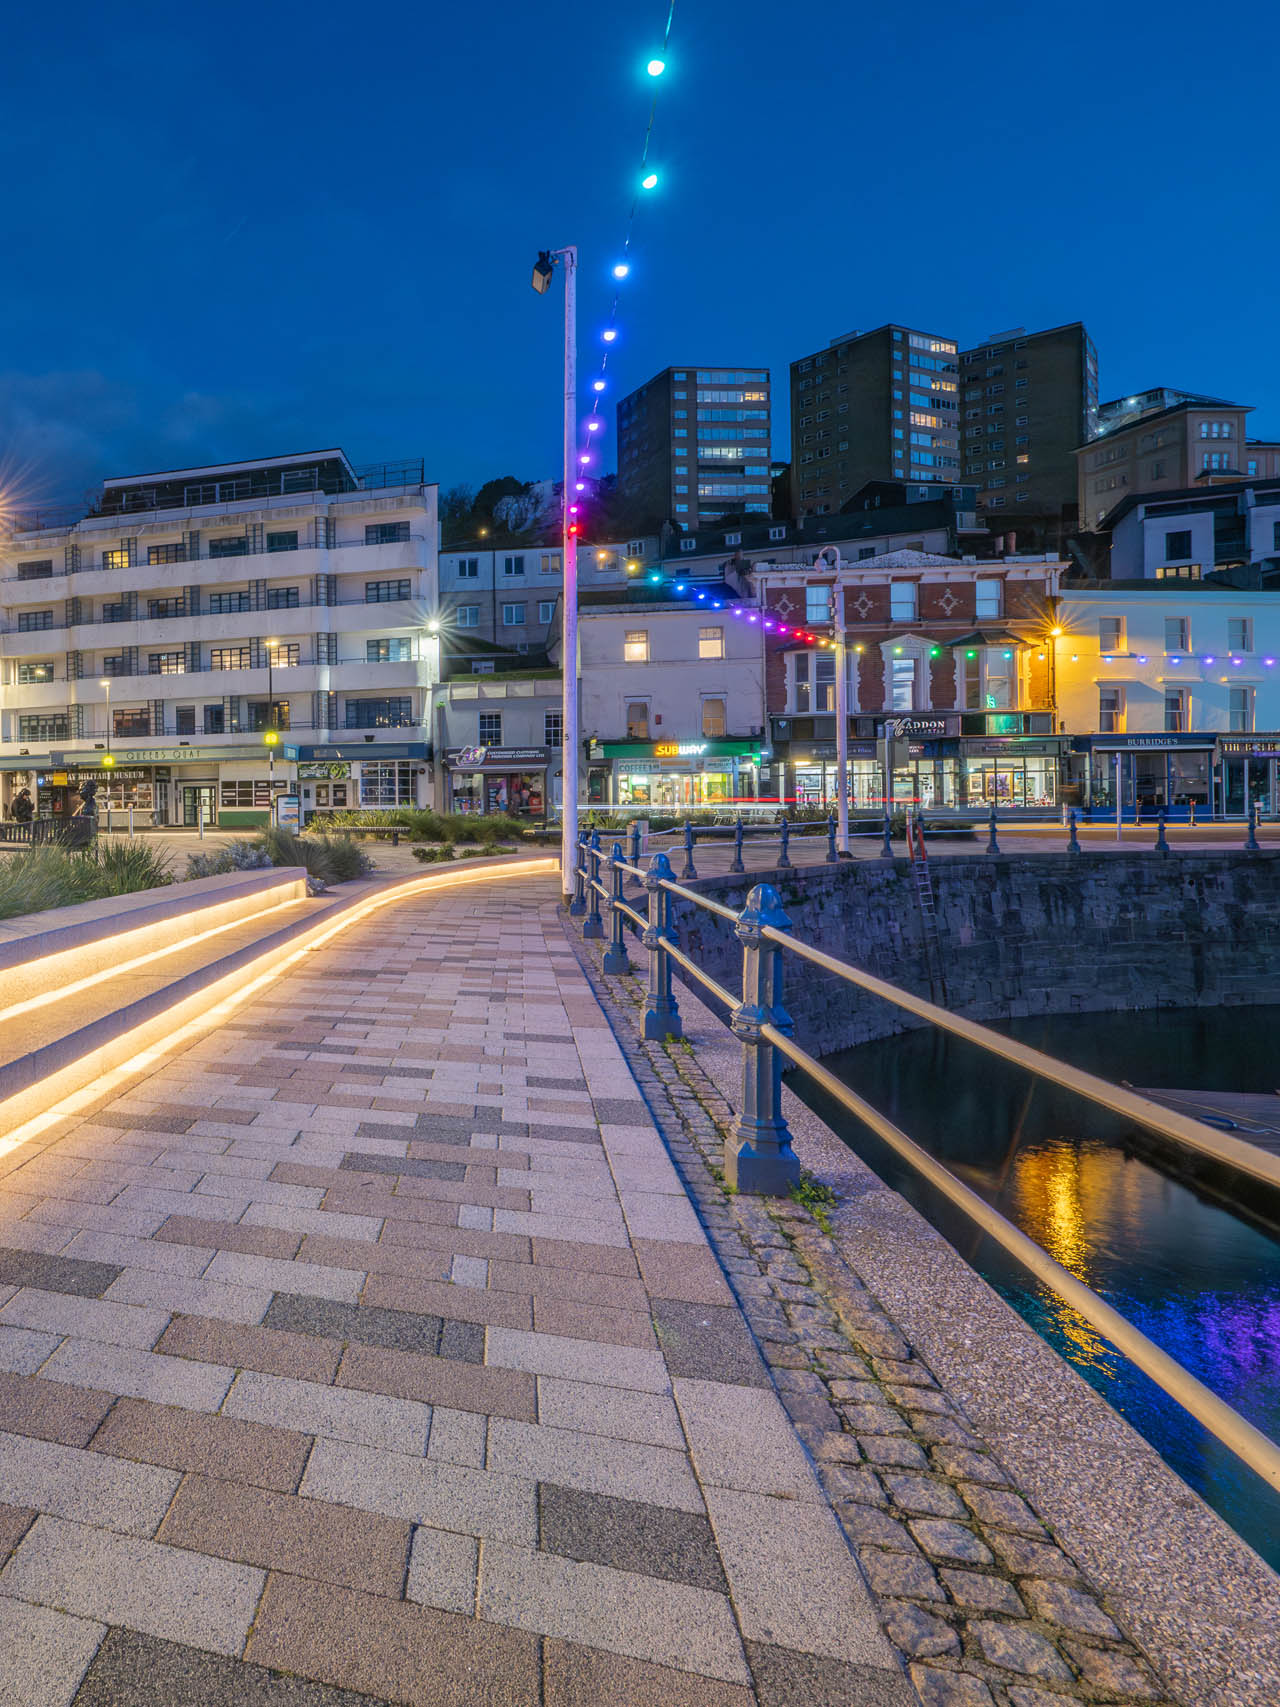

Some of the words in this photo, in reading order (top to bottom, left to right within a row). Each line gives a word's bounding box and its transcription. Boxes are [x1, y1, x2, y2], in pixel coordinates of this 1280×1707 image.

[656, 745, 705, 754] SUBWAY
[127, 751, 166, 760] QUEENS
[173, 750, 200, 759] QUAY
[114, 771, 145, 779] MUSEUM
